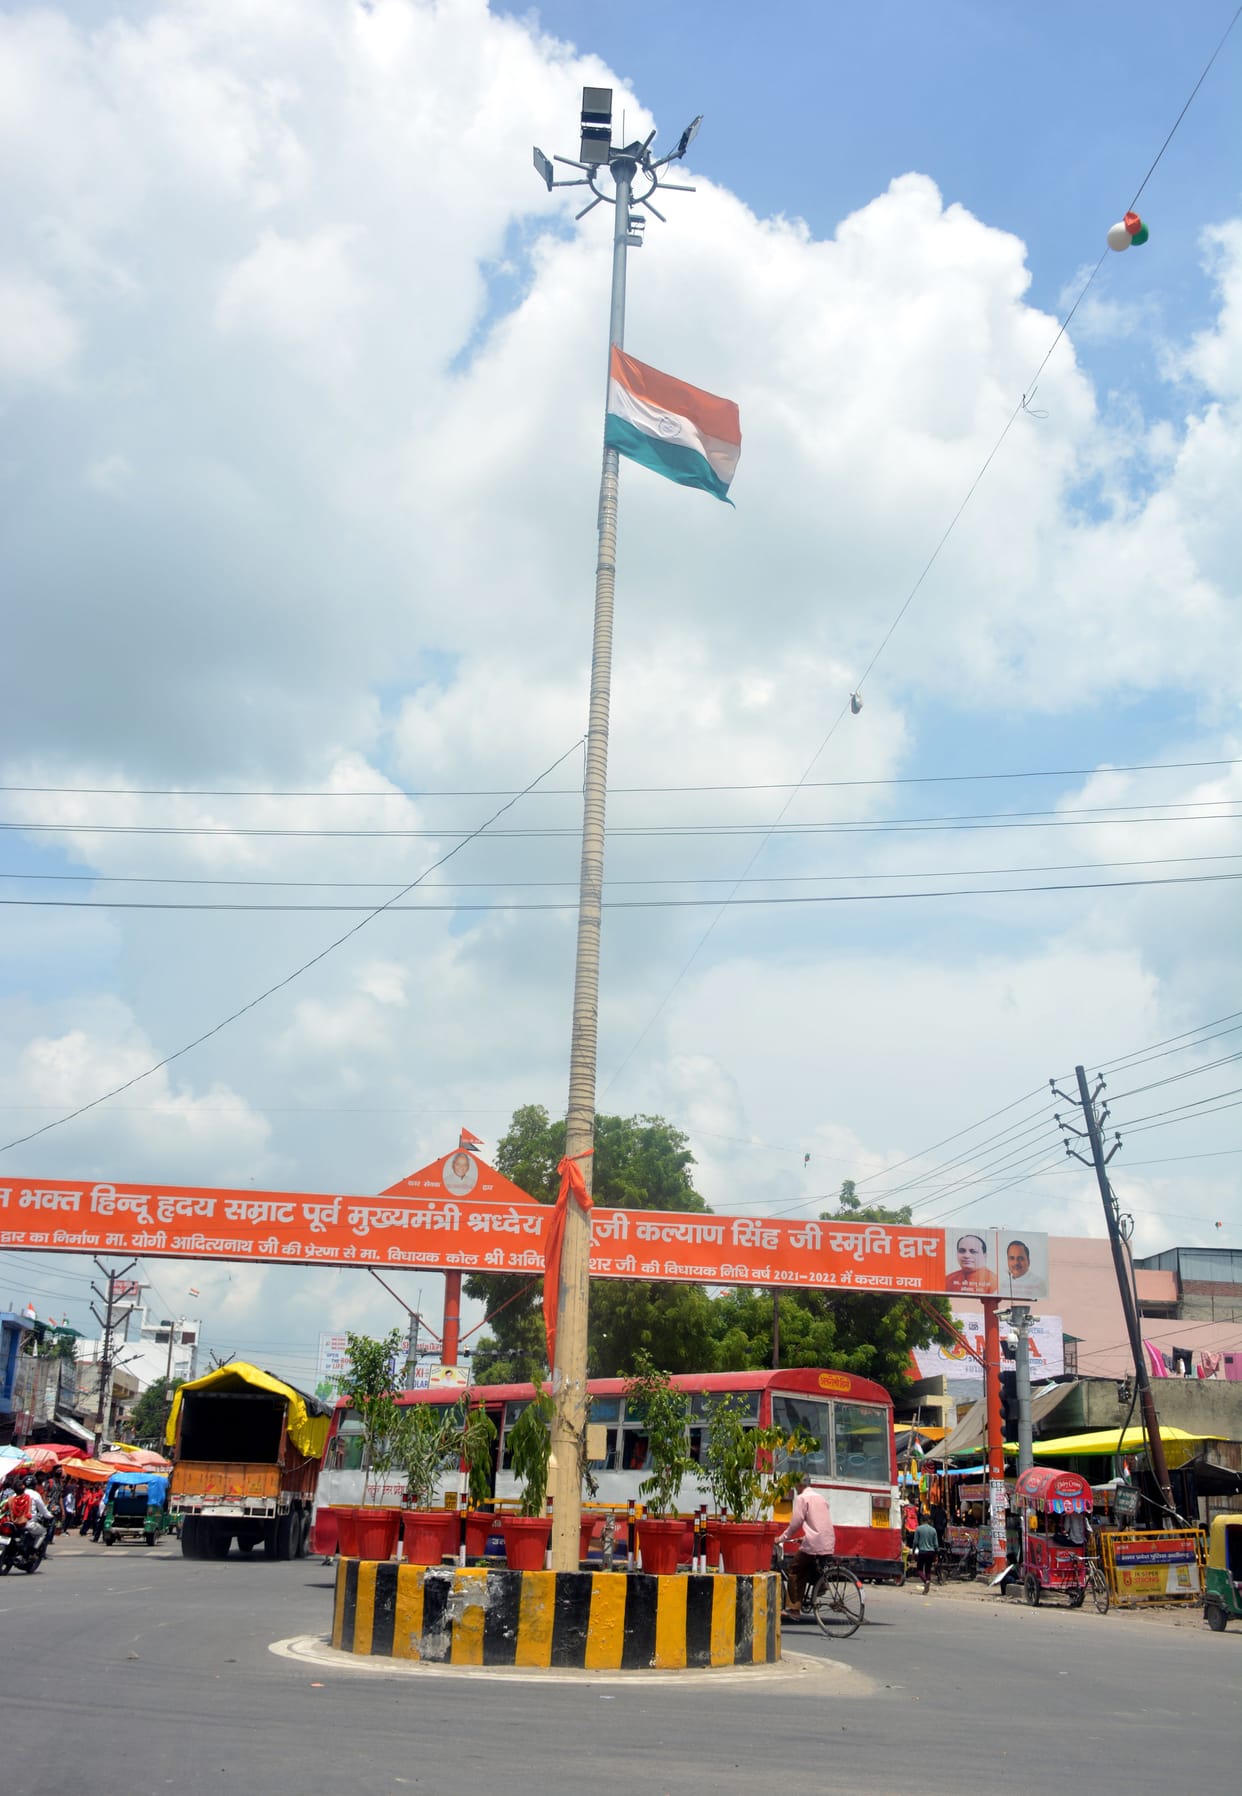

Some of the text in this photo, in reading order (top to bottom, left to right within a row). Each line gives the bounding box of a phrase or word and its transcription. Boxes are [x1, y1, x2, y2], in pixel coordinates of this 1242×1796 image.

[18, 1188, 83, 1211] भक्त
[90, 1184, 154, 1225] हिन्दू
[157, 1195, 217, 1223] हृदय
[224, 1199, 297, 1225] सम्राट
[302, 1197, 343, 1232] पूर्व
[348, 1202, 462, 1236] मुख्यमंत्री
[636, 1221, 725, 1246] कल्याण
[731, 1218, 781, 1249] सिंह
[788, 1223, 822, 1251] जी
[829, 1226, 892, 1261] स्मृति
[898, 1235, 940, 1259] द्वार
[1, 1230, 26, 1243] द्वार
[30, 1231, 49, 1244] का
[53, 1229, 100, 1246] निर्माण
[105, 1232, 128, 1247] मा.
[131, 1230, 167, 1249] योगी
[170, 1233, 253, 1254] आदित्यनाथ
[258, 1236, 280, 1255] जी
[281, 1237, 302, 1256] की
[304, 1242, 339, 1259] प्रेरणा
[343, 1243, 357, 1259] से
[360, 1248, 381, 1260] मा.
[387, 1246, 441, 1264] विधायक
[445, 1249, 479, 1266] कोल
[484, 1247, 505, 1266] श्री
[615, 1253, 638, 1273] जी
[641, 1259, 660, 1274] की
[664, 1261, 718, 1277] विधायक
[720, 1263, 749, 1279] निधि
[752, 1264, 771, 1280] वर्ष
[840, 1269, 854, 1285] में
[855, 1274, 894, 1288] कराया
[896, 1275, 922, 1288] गया
